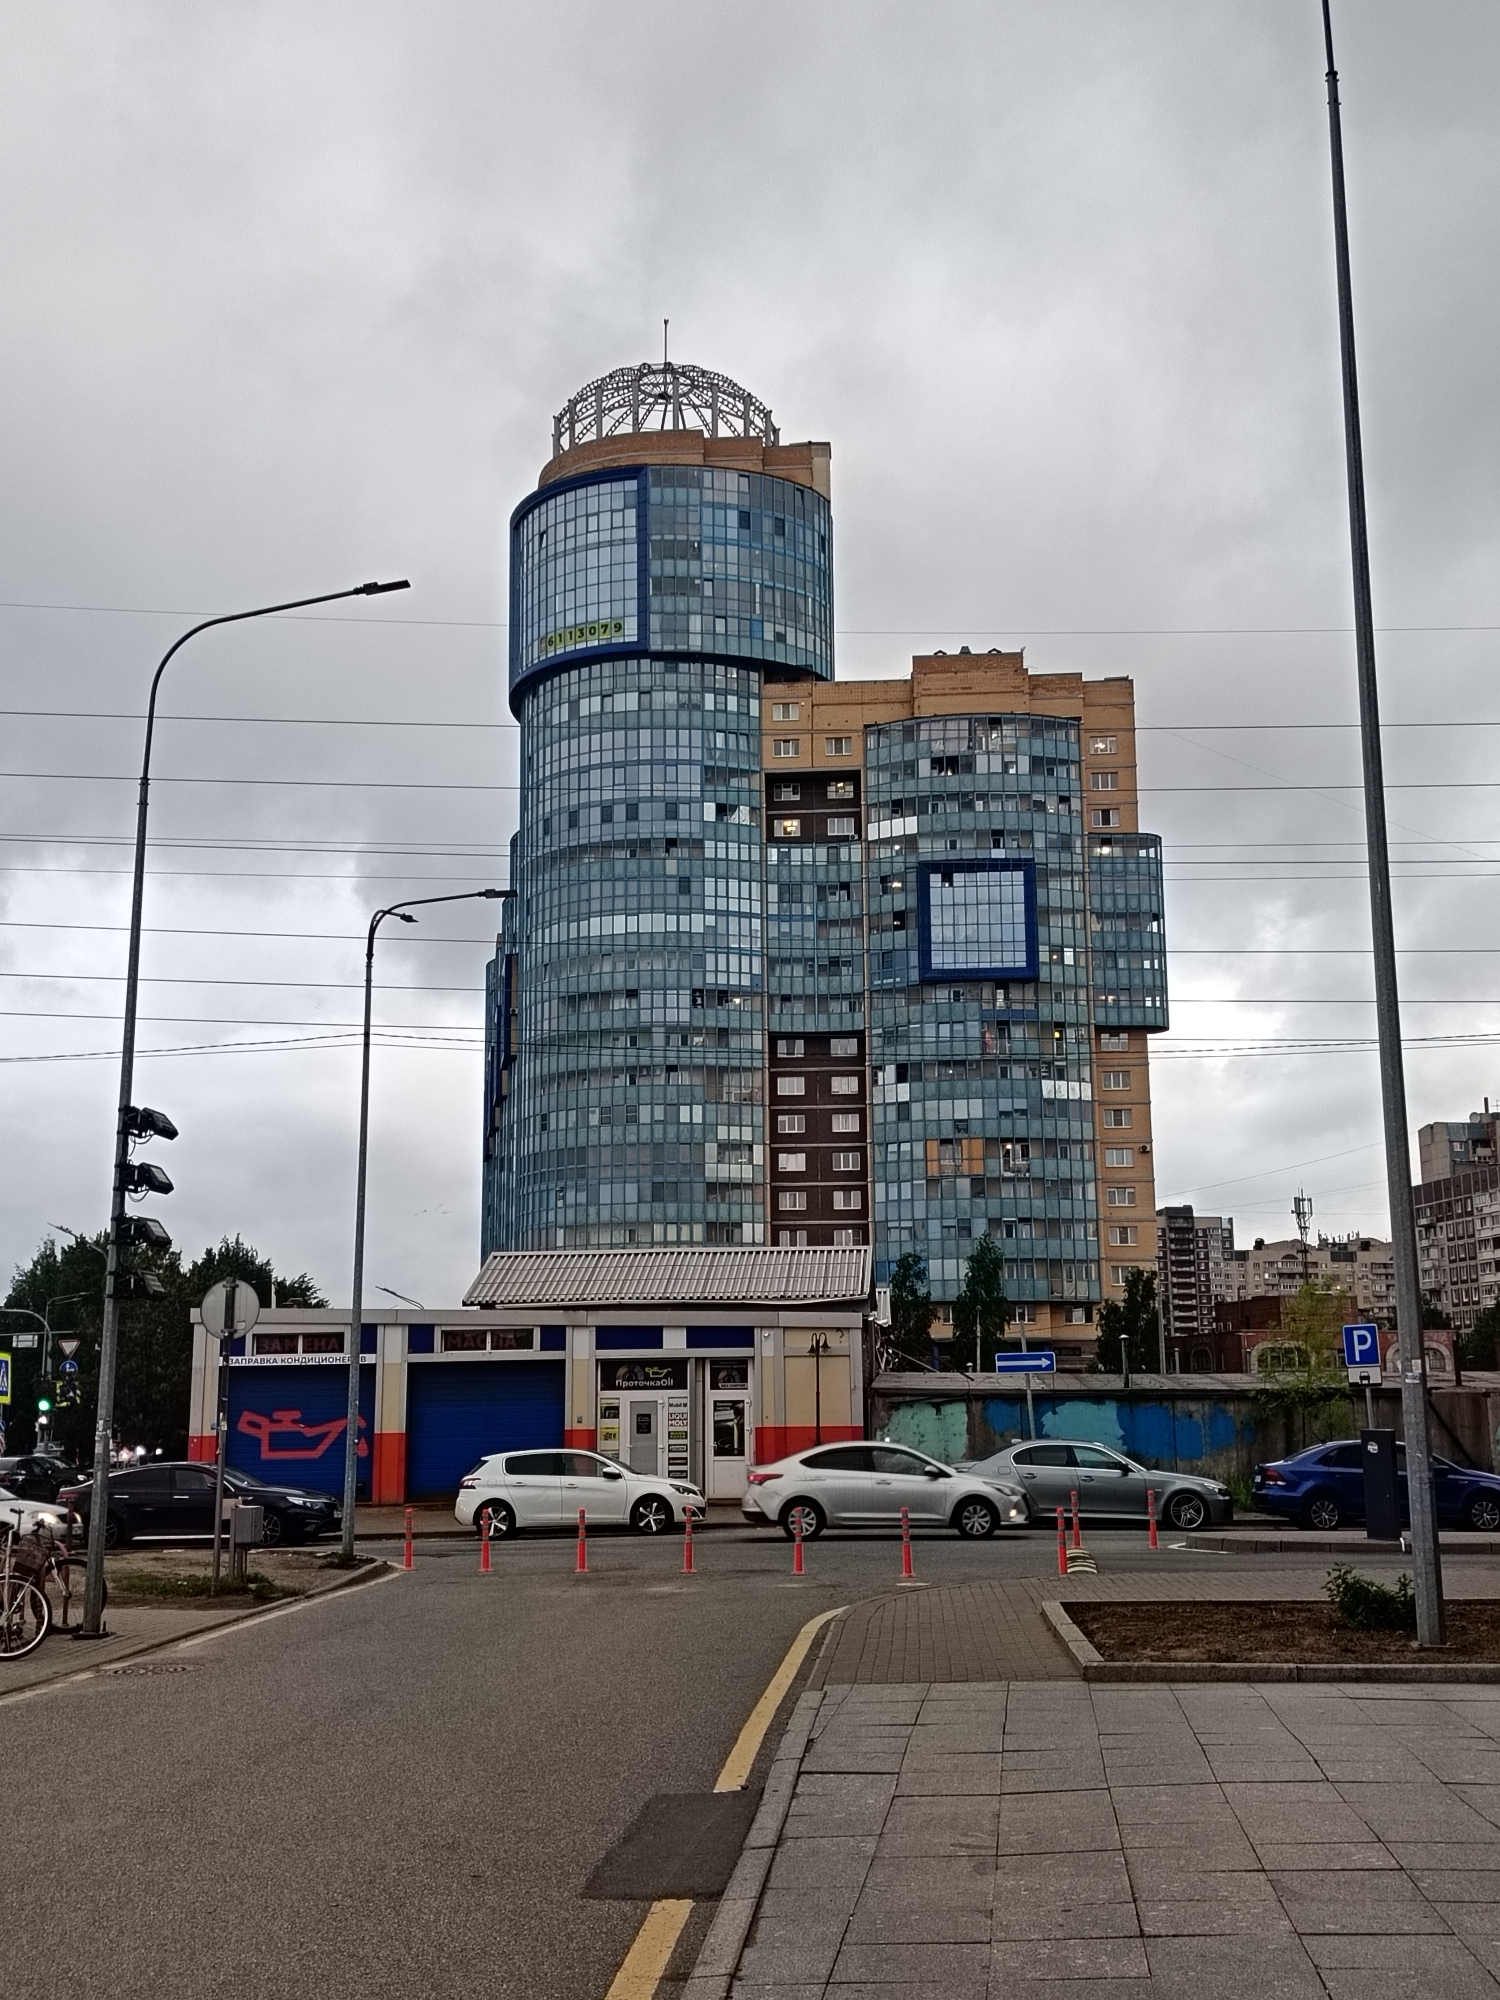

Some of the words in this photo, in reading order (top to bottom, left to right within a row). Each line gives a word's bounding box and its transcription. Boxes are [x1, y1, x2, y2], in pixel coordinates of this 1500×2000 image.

[547, 622, 623, 647] 6113079
[259, 1337, 340, 1352] ЗАМЕНА
[1353, 1329, 1372, 1362] P
[228, 1357, 278, 1365] ЗАПРАВКА
[280, 1355, 367, 1364] КОНДИЦИОНЕРВ
[615, 1377, 674, 1389] ПроточкаOil
